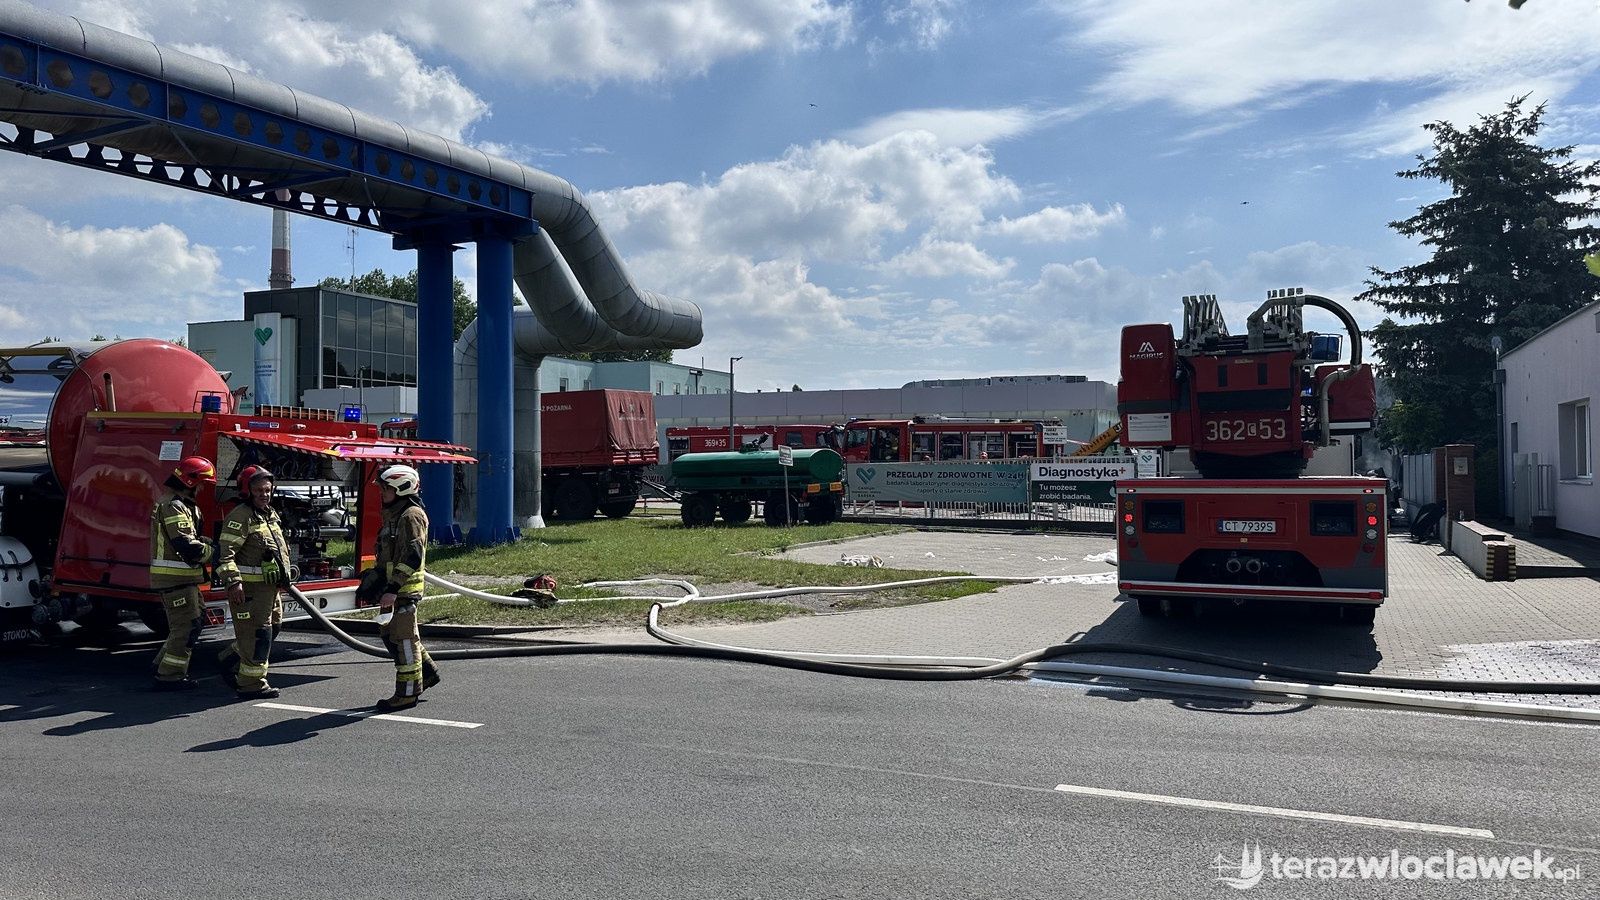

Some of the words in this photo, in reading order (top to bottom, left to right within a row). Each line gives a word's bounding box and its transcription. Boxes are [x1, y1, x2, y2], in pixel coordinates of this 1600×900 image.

[1129, 352, 1164, 360] MAGIRUS
[937, 471, 993, 479] ZDROWOTNE
[1224, 521, 1238, 531] CT
[1241, 521, 1274, 532] 7939S
